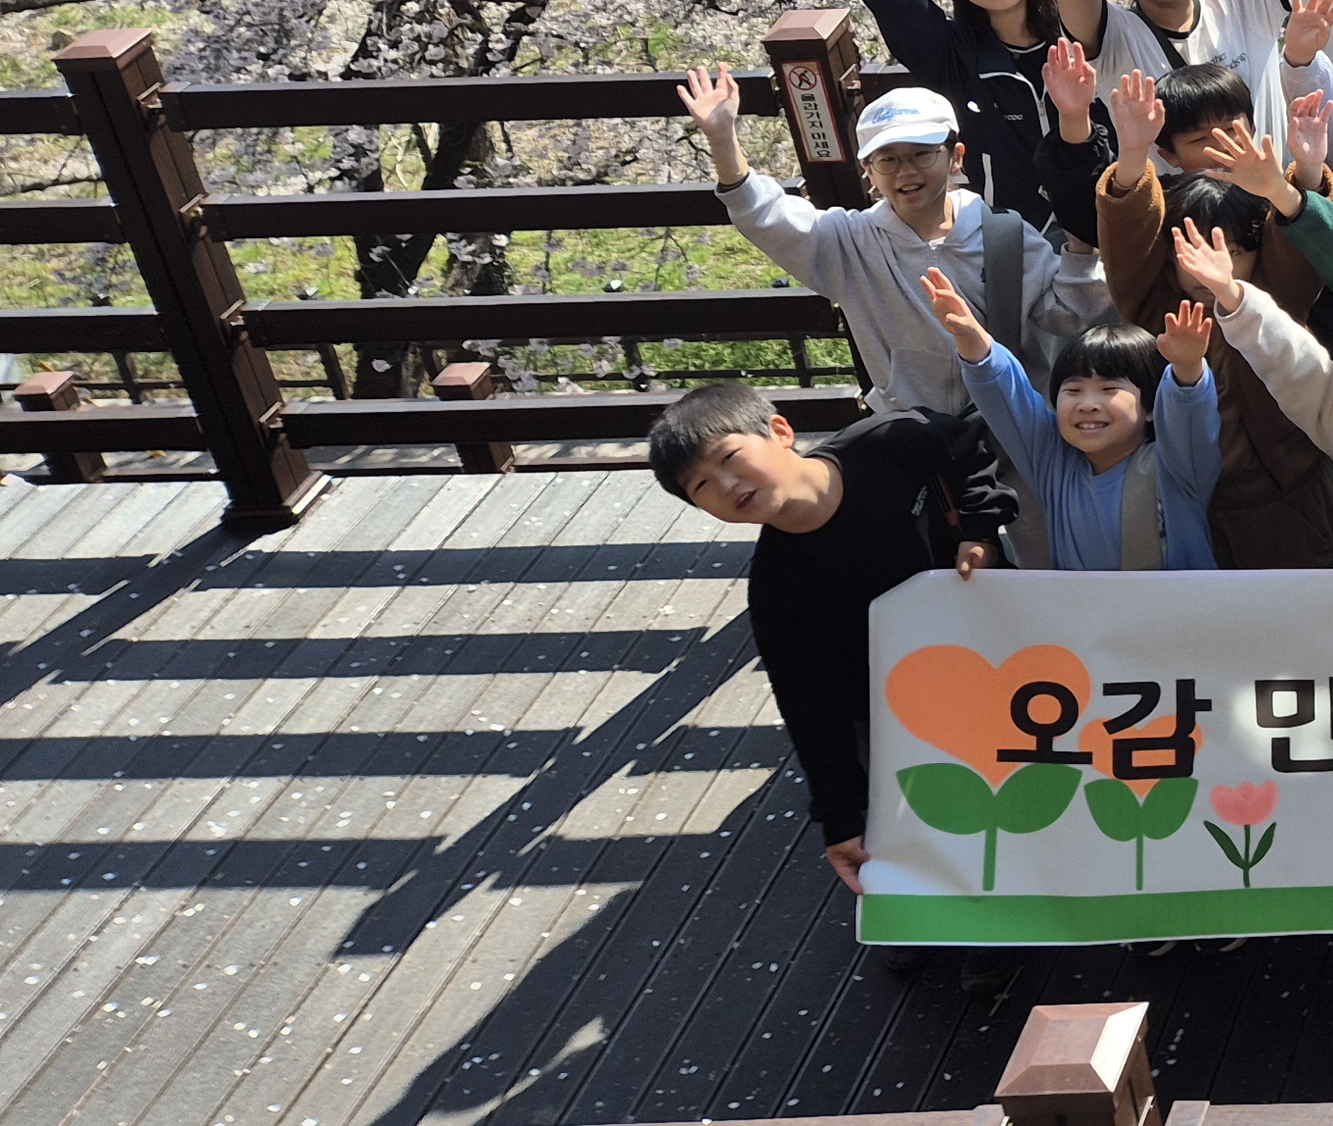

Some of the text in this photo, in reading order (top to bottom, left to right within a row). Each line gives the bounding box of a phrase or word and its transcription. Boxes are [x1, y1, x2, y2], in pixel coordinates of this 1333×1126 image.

[799, 93, 833, 159] 올라가지 마세요
[996, 677, 1213, 781] 오감
